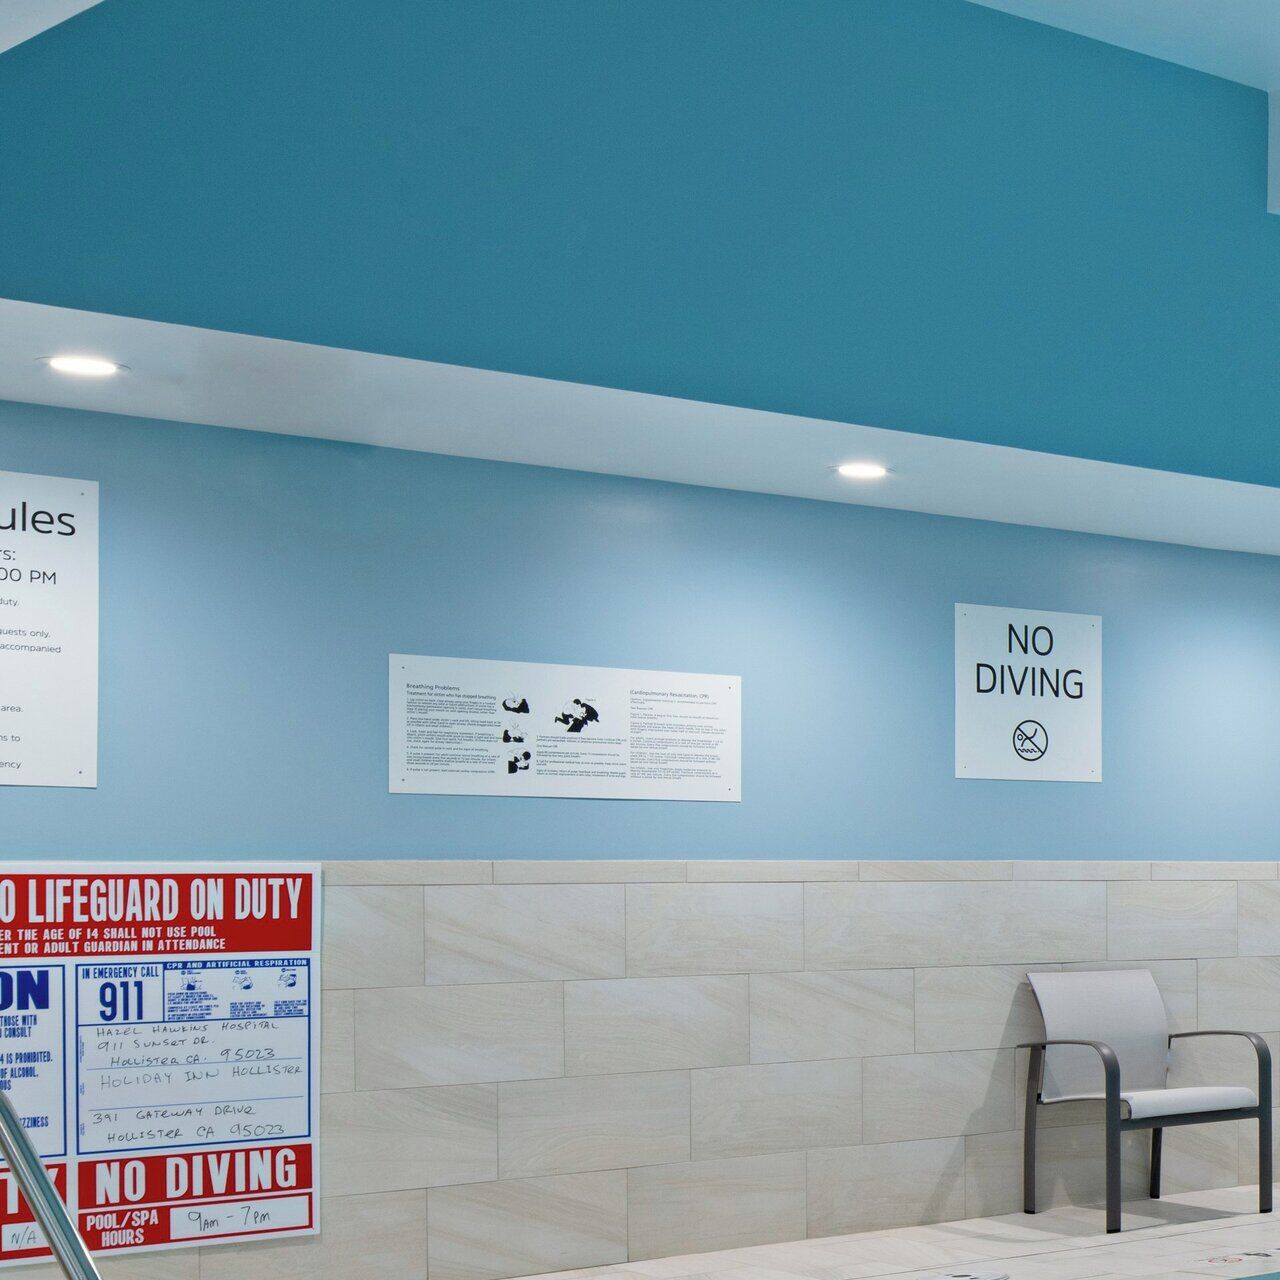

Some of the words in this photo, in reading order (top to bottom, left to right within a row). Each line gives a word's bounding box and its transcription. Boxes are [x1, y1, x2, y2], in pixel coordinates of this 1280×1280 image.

[30, 569, 57, 585] PM
[29, 630, 51, 639] only.
[1007, 623, 1054, 657] NO
[406, 683, 434, 691] Breathing
[435, 684, 460, 692] Problems
[976, 663, 1084, 700] DIVING
[0, 705, 24, 713] area.
[28, 878, 179, 924] LIFEGUARD
[190, 878, 224, 921] ON
[234, 877, 303, 920] DUTY
[17, 929, 38, 941] THE
[43, 928, 64, 941] AGE
[68, 928, 83, 940] OF
[87, 927, 99, 940] 14
[103, 926, 137, 940] SHALL
[142, 926, 162, 939] NOT
[166, 926, 187, 939] USE
[191, 925, 217, 938] POOL
[24, 942, 39, 954] OR
[43, 941, 80, 955] ADULT
[84, 940, 138, 954] GUARDIAN
[142, 939, 153, 951] IN
[157, 938, 226, 952] ATTENDANCE
[206, 960, 251, 968] ARTIFICIAL
[254, 959, 307, 967] RESPIRATION
[82, 967, 91, 980] IN
[93, 966, 138, 979] EMERGENCY
[140, 965, 160, 978] CALL
[99, 980, 143, 1022] 911
[21, 1014, 37, 1026] WITH
[4, 1026, 31, 1038] CONSULT
[97, 1041, 123, 1052] 911
[6, 1052, 13, 1065] IS
[15, 1051, 53, 1063] PROHIBITED.
[220, 1048, 275, 1062] 95023
[10, 1066, 39, 1079] ALCOHOL.
[100, 1072, 172, 1091] HOLIDAY
[184, 1068, 220, 1083] INN
[92, 1113, 118, 1125] 391
[196, 1125, 215, 1137] CA
[229, 1123, 285, 1137] 95023
[95, 1160, 147, 1206] NO
[166, 1148, 298, 1200] DIVING
[86, 1208, 159, 1232] POOL/SPA
[11, 1225, 37, 1249] N/A
[101, 1228, 145, 1248] HOURS
